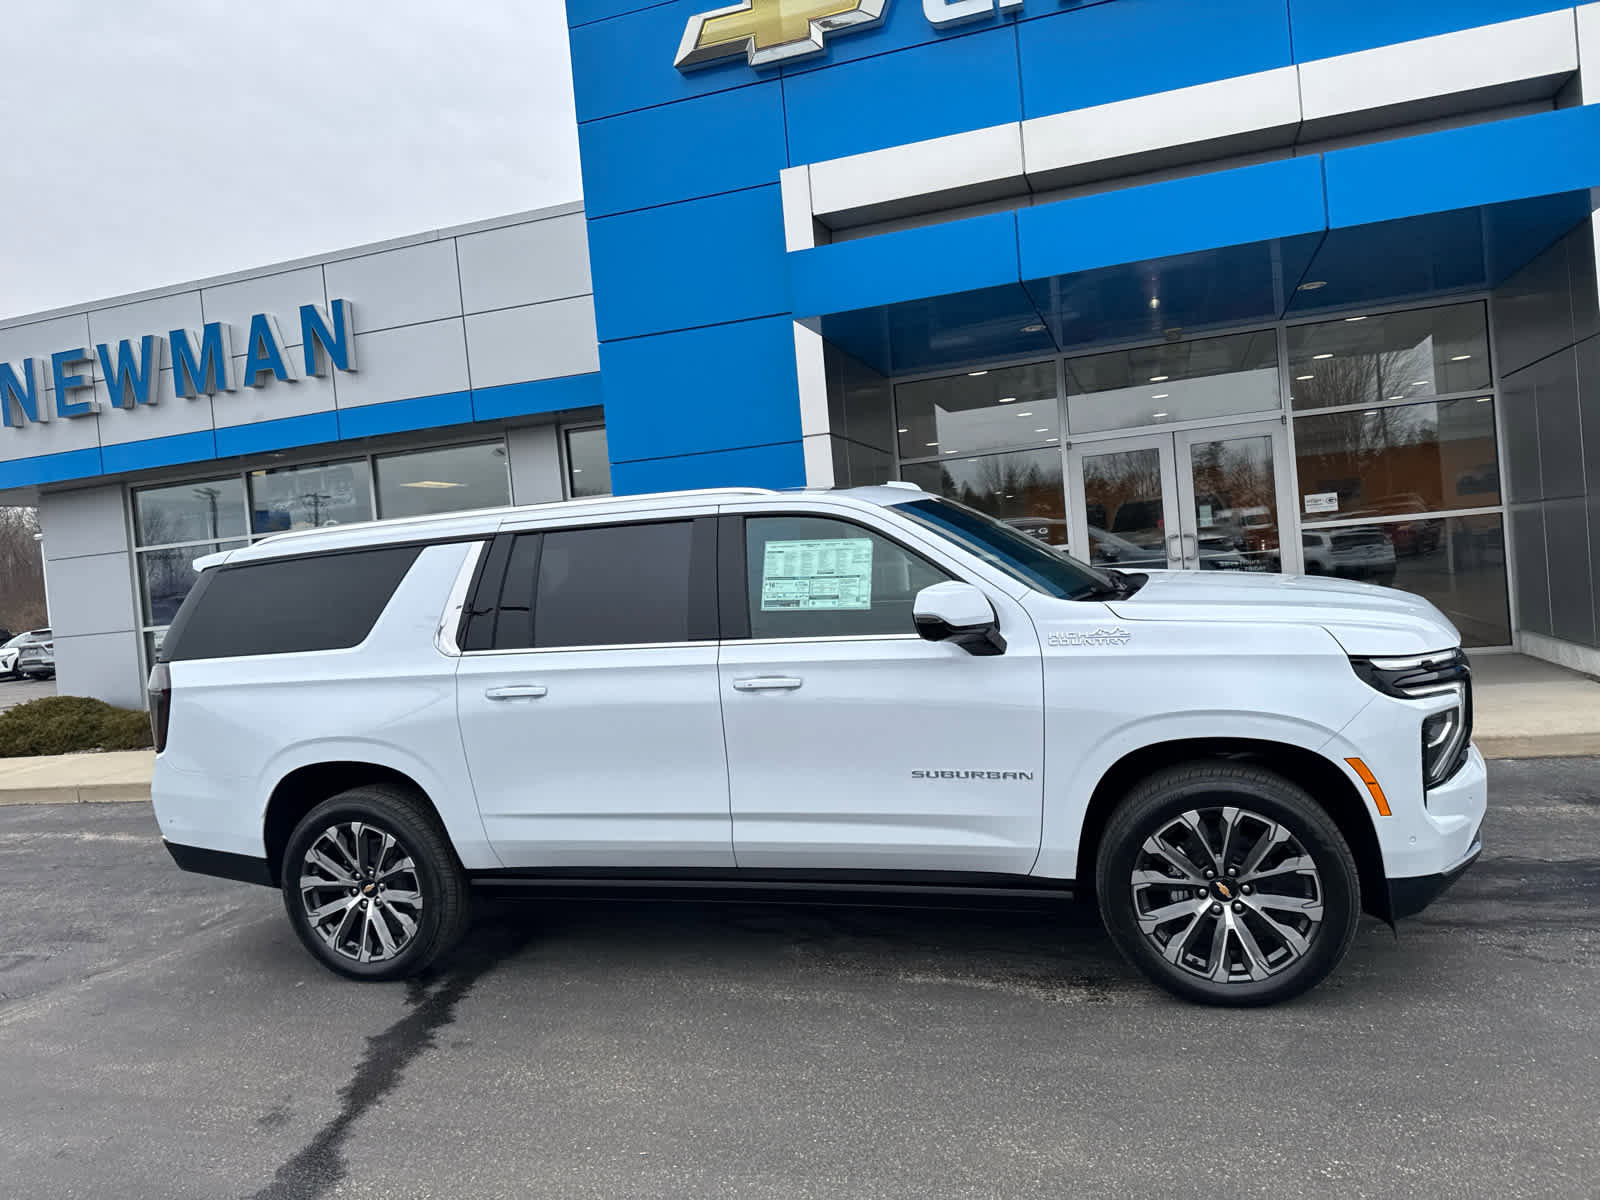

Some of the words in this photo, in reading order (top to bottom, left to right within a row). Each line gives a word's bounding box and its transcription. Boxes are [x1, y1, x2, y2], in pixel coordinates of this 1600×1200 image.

[0, 299, 356, 427] NEWMAN
[1047, 631, 1089, 639] HIGH
[1047, 638, 1131, 646] COUNTRY
[911, 770, 1034, 780] SUBURBAN
